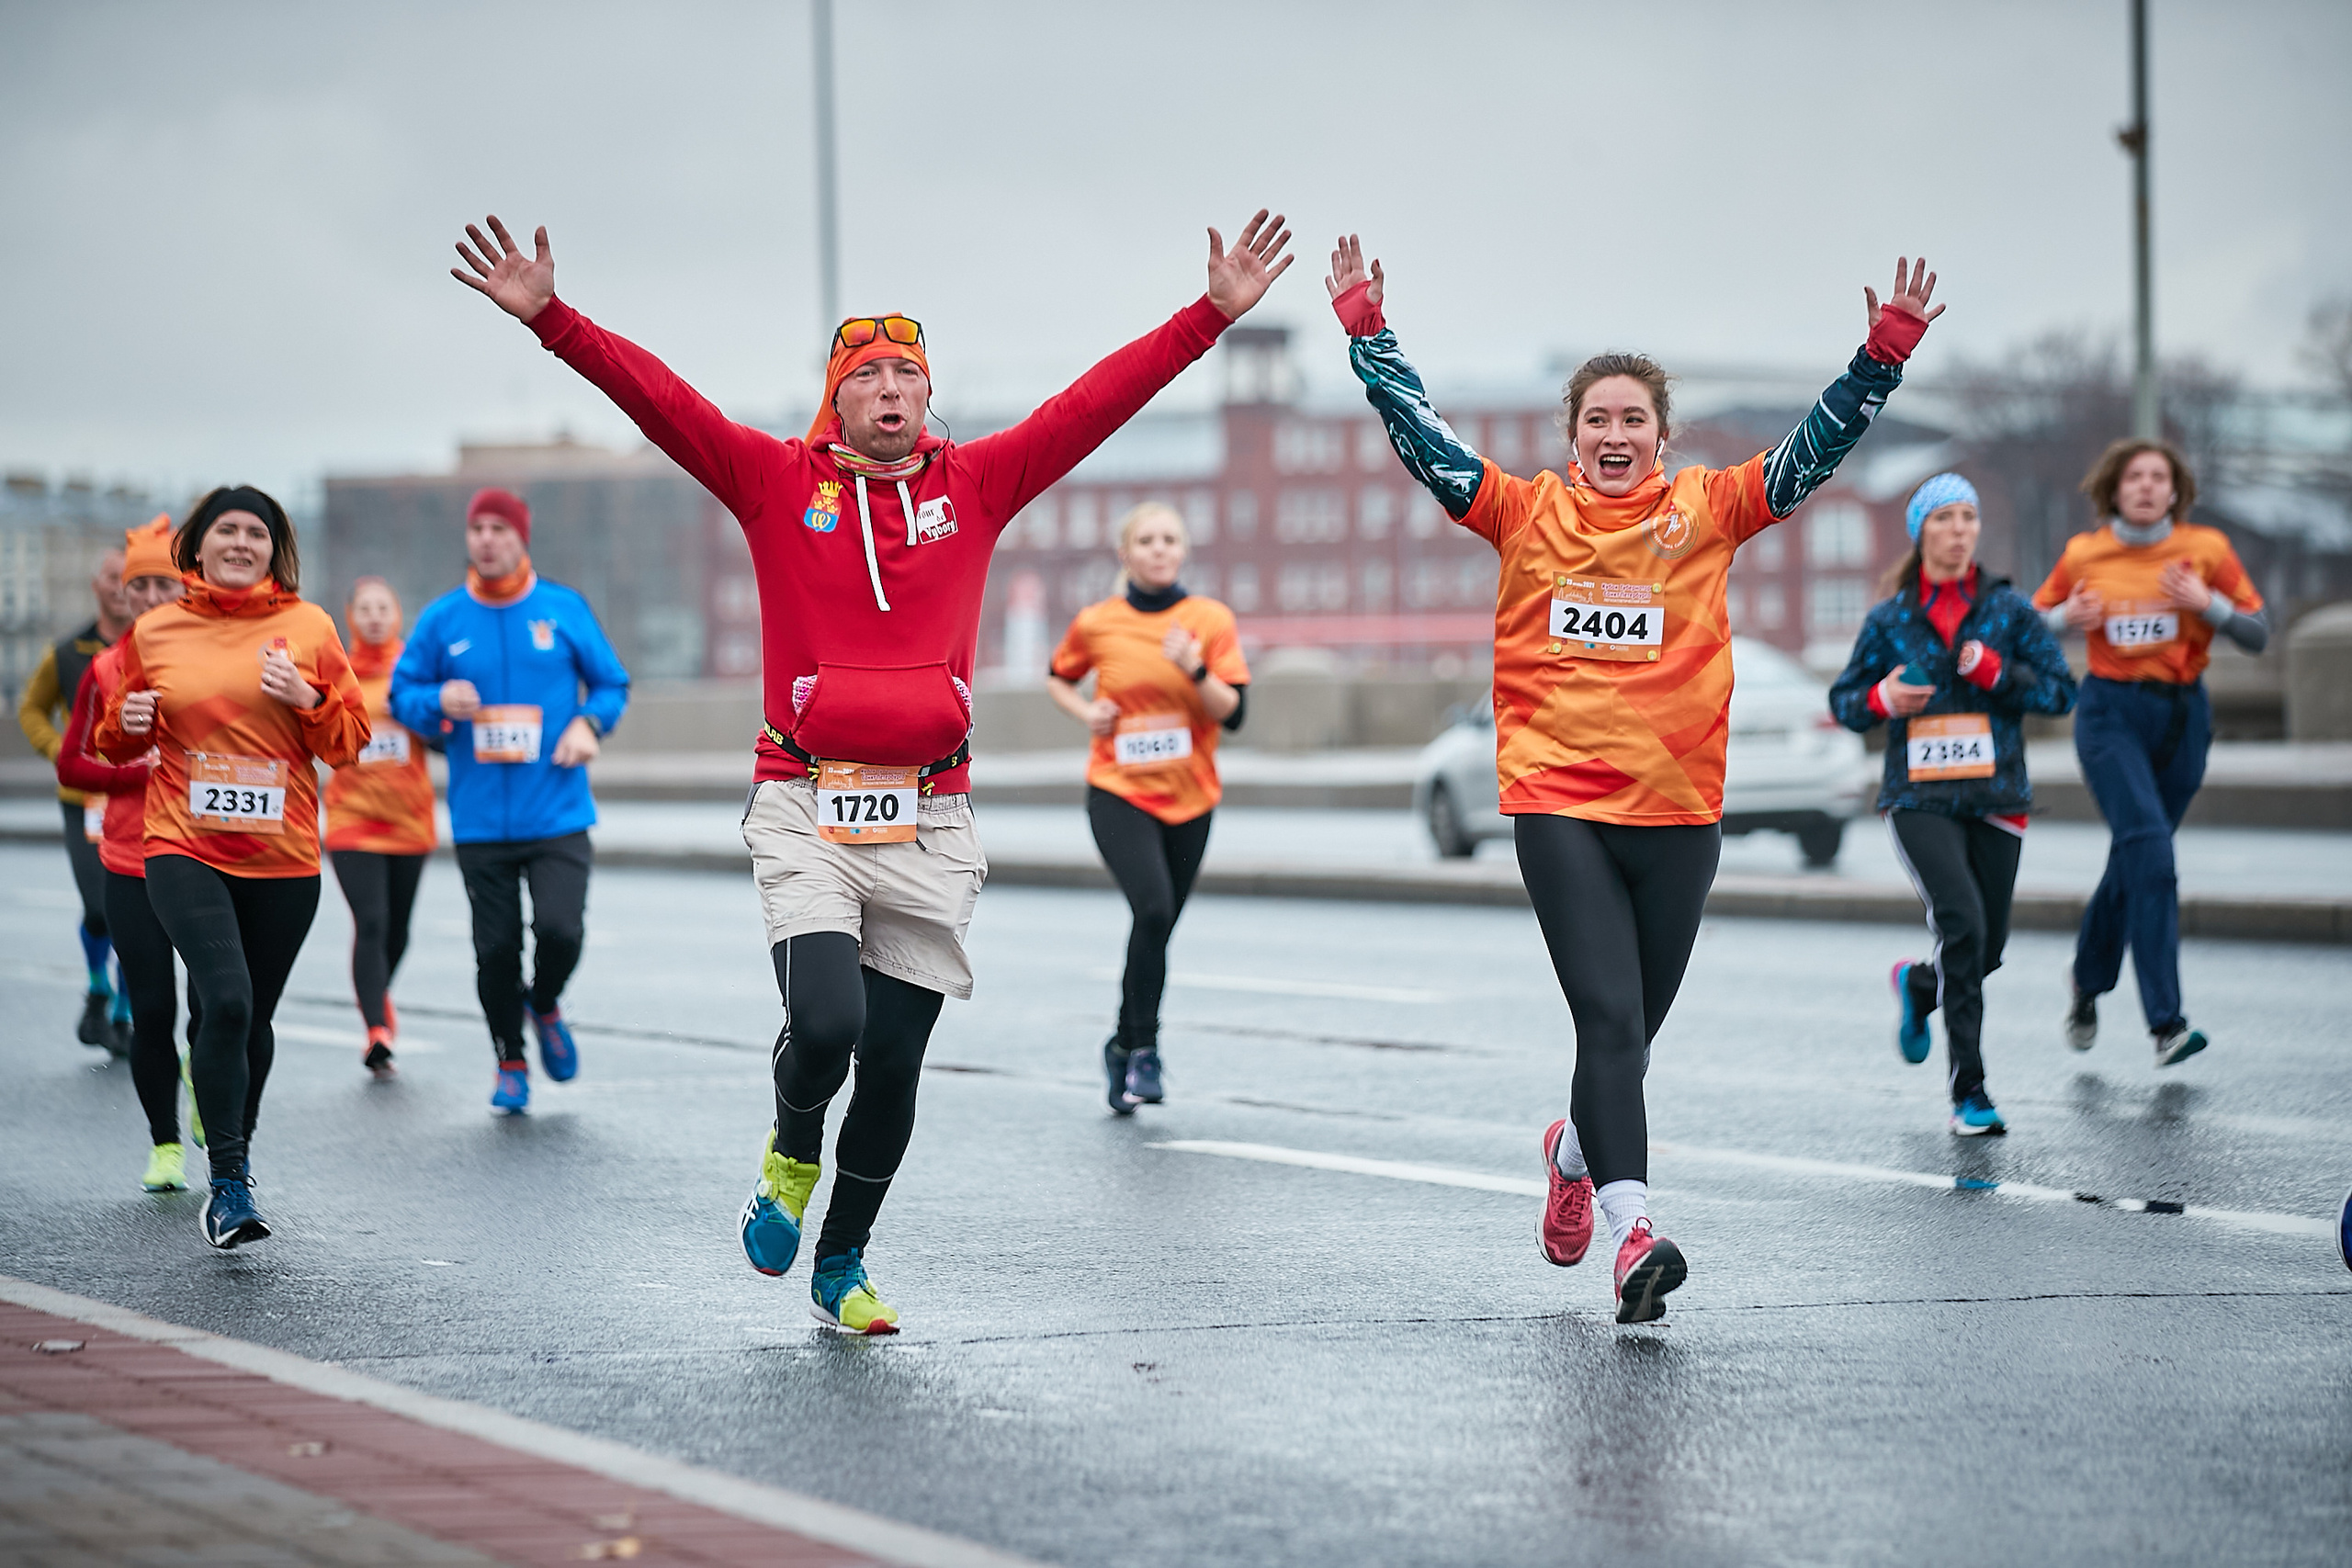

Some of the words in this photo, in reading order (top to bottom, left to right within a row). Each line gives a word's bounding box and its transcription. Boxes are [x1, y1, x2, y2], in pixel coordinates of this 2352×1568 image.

[924, 520, 956, 540] Vyborg
[1563, 607, 1648, 640] 2404
[1919, 739, 1981, 761] 2384
[205, 788, 269, 815] 2331
[831, 794, 899, 822] 1720
